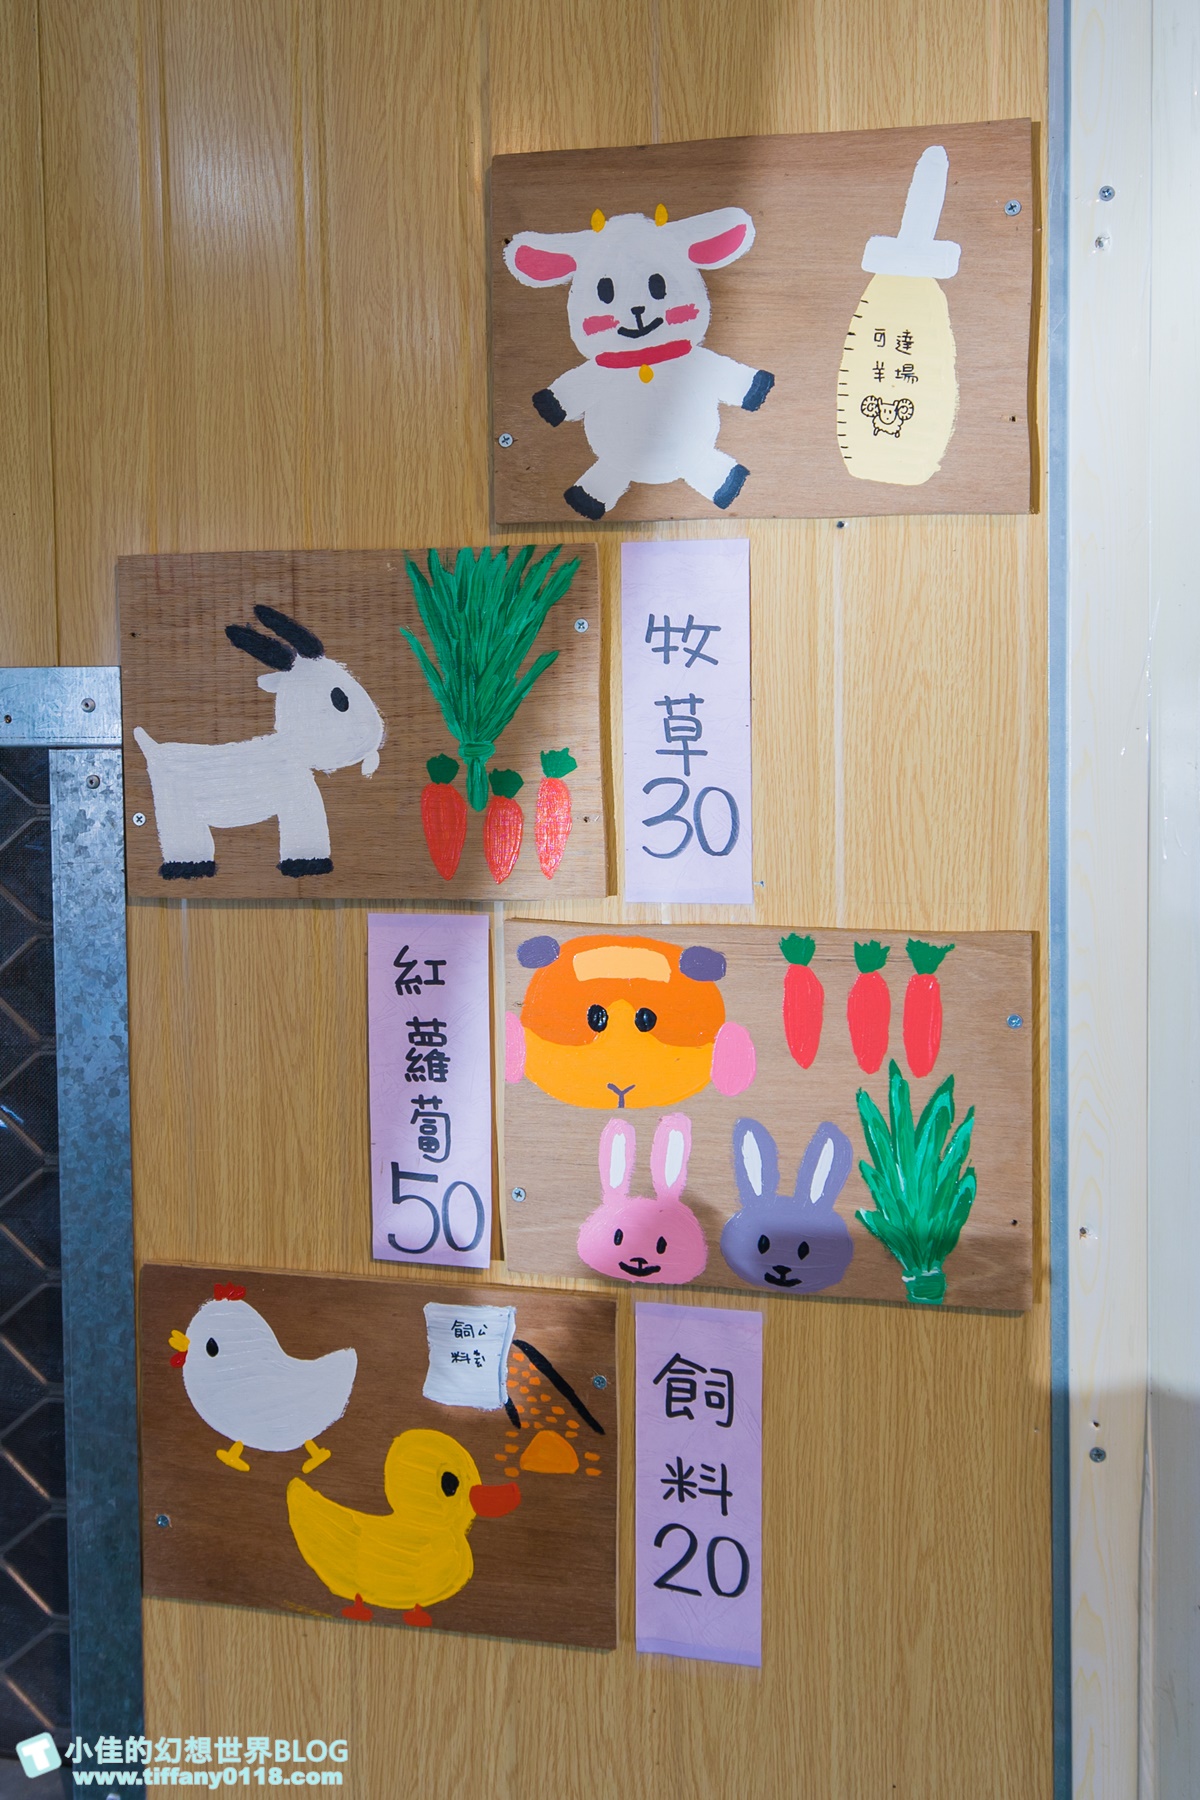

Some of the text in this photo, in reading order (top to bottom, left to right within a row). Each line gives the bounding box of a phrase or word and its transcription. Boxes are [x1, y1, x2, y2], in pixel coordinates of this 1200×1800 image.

[872, 360, 919, 384] 羊場
[873, 328, 915, 355] 可達
[645, 613, 722, 777] 牧草
[642, 777, 740, 859] 30
[393, 945, 452, 1164] 紅蘿蔔
[387, 1161, 486, 1255] 50
[653, 1353, 734, 1516] 飼料
[653, 1523, 750, 1598] 20
